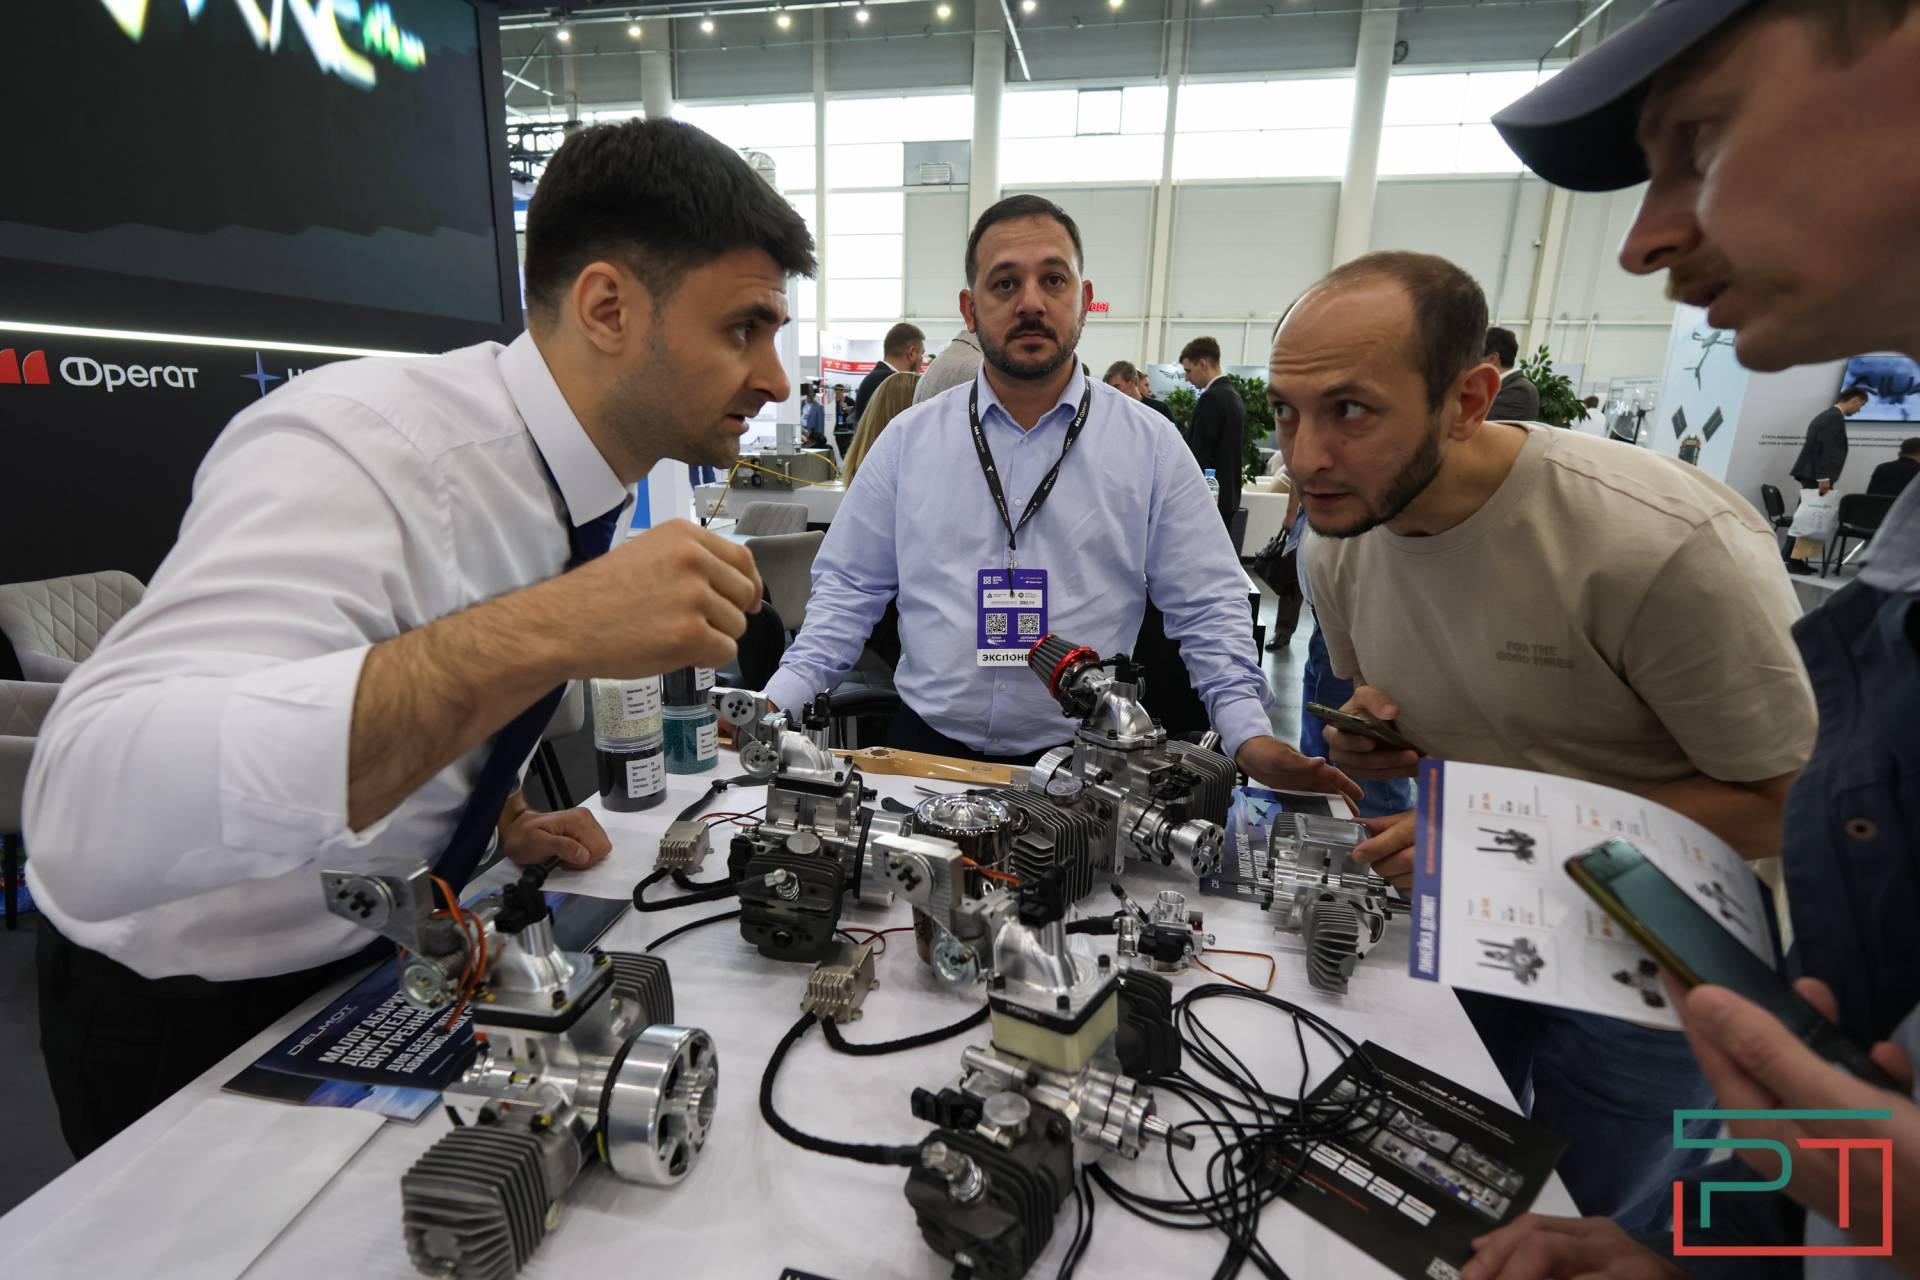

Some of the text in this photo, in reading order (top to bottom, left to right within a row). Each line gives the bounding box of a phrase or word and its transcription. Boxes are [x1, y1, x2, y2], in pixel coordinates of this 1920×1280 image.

[59, 355, 199, 392] Фрегат
[287, 1003, 353, 1056] DELMOT
[340, 1005, 417, 1067] ДВИГАТЕЛИ
[386, 1053, 413, 1072] ДЛЯ
